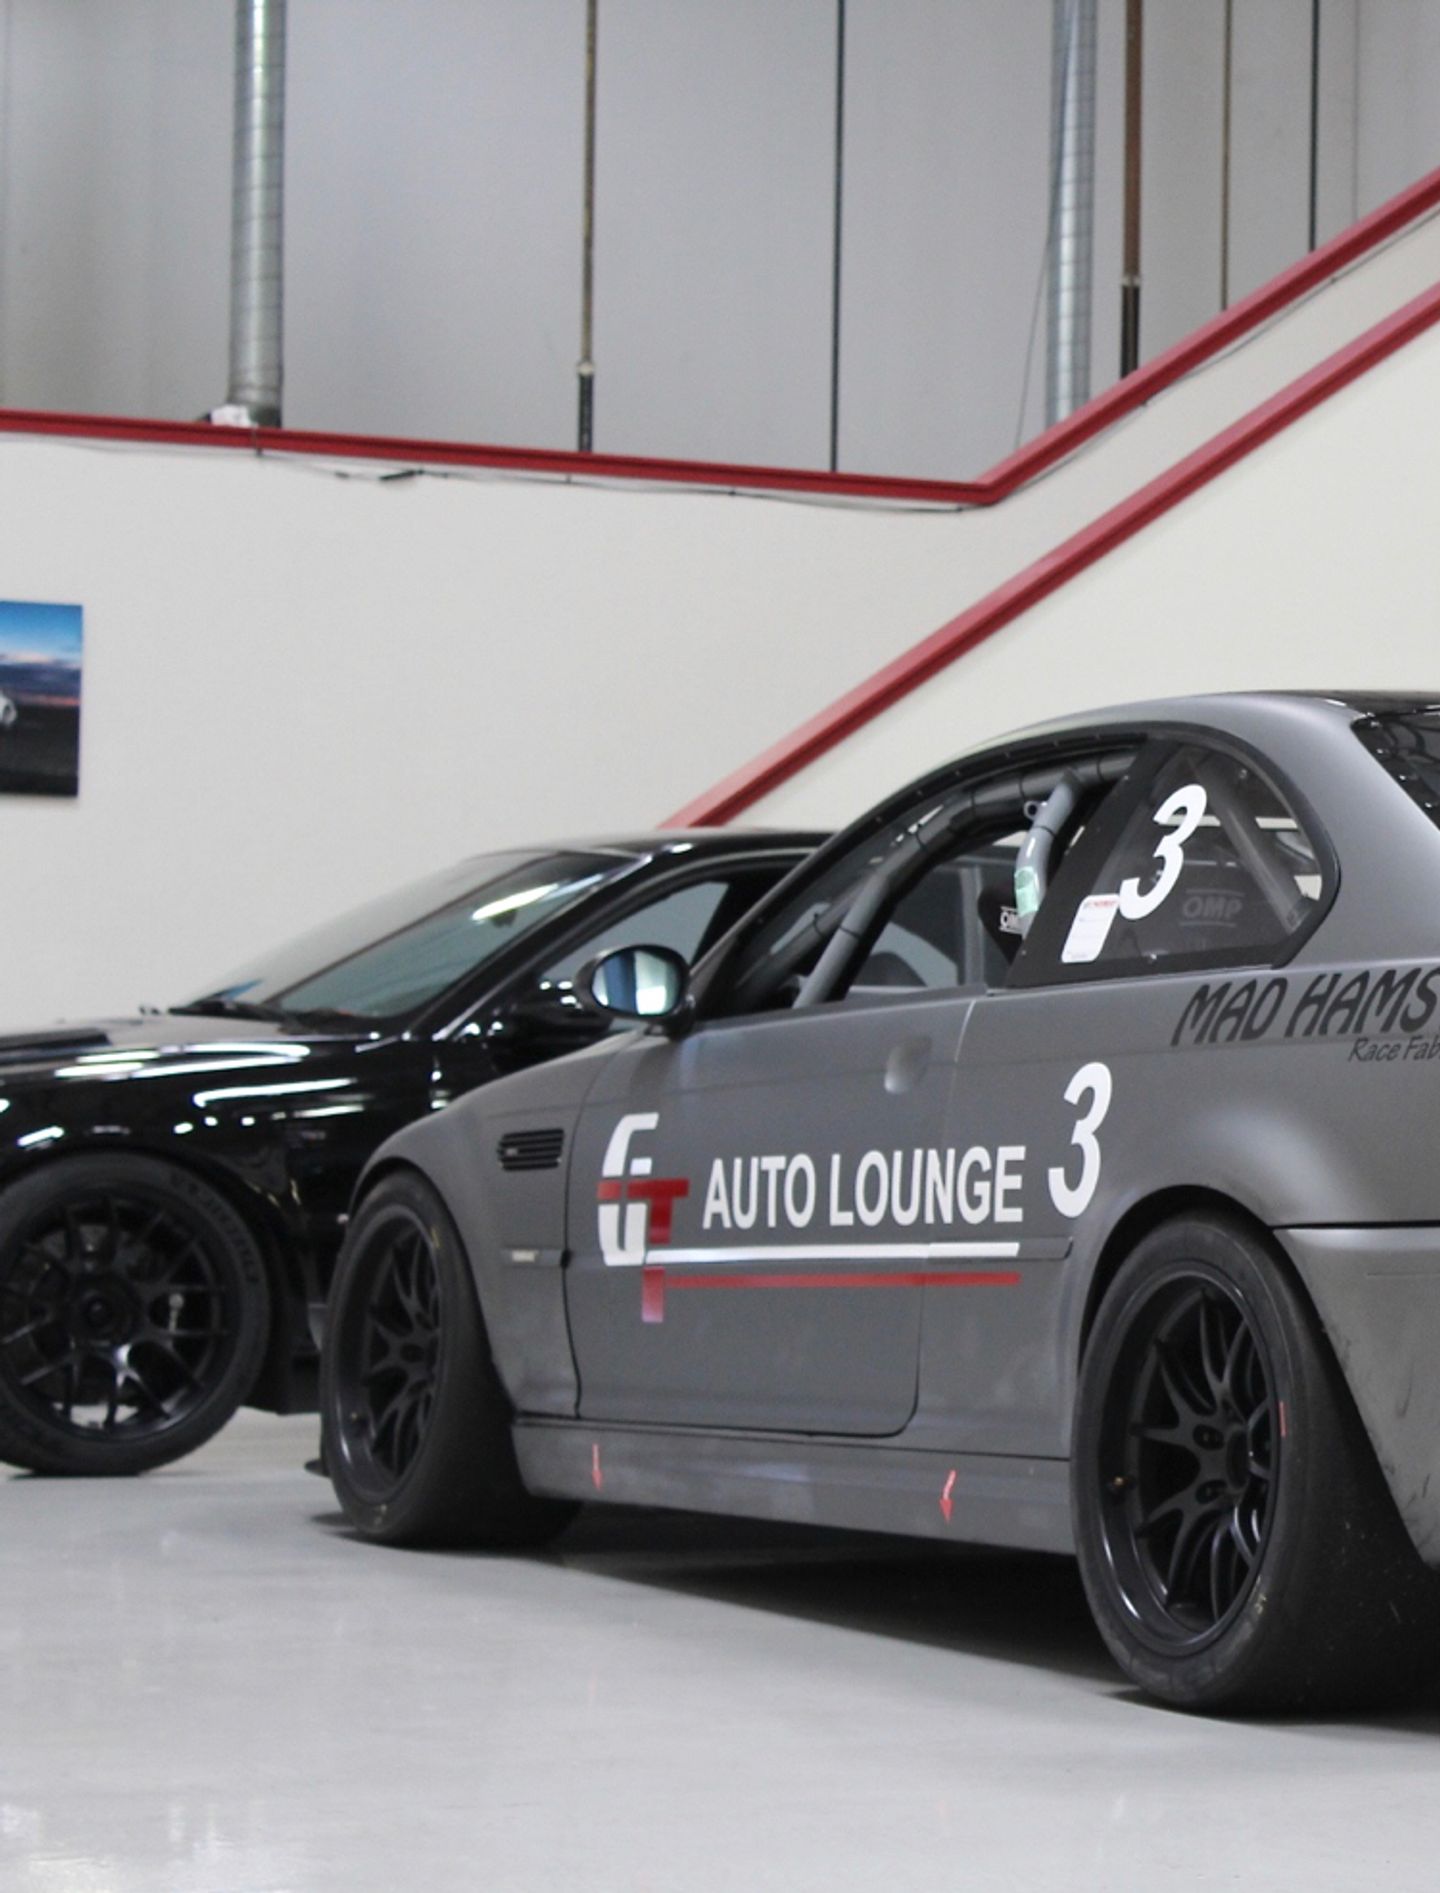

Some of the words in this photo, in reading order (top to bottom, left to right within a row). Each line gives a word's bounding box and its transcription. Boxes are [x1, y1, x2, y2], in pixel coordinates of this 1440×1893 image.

[1119, 783, 1206, 919] 3
[1183, 896, 1243, 919] OMP
[1170, 977, 1288, 1047] MAD
[1347, 1037, 1402, 1062] Race
[1048, 1061, 1113, 1219] 3
[702, 1153, 816, 1230] AUTO
[829, 1145, 1027, 1226] LOUNGE
